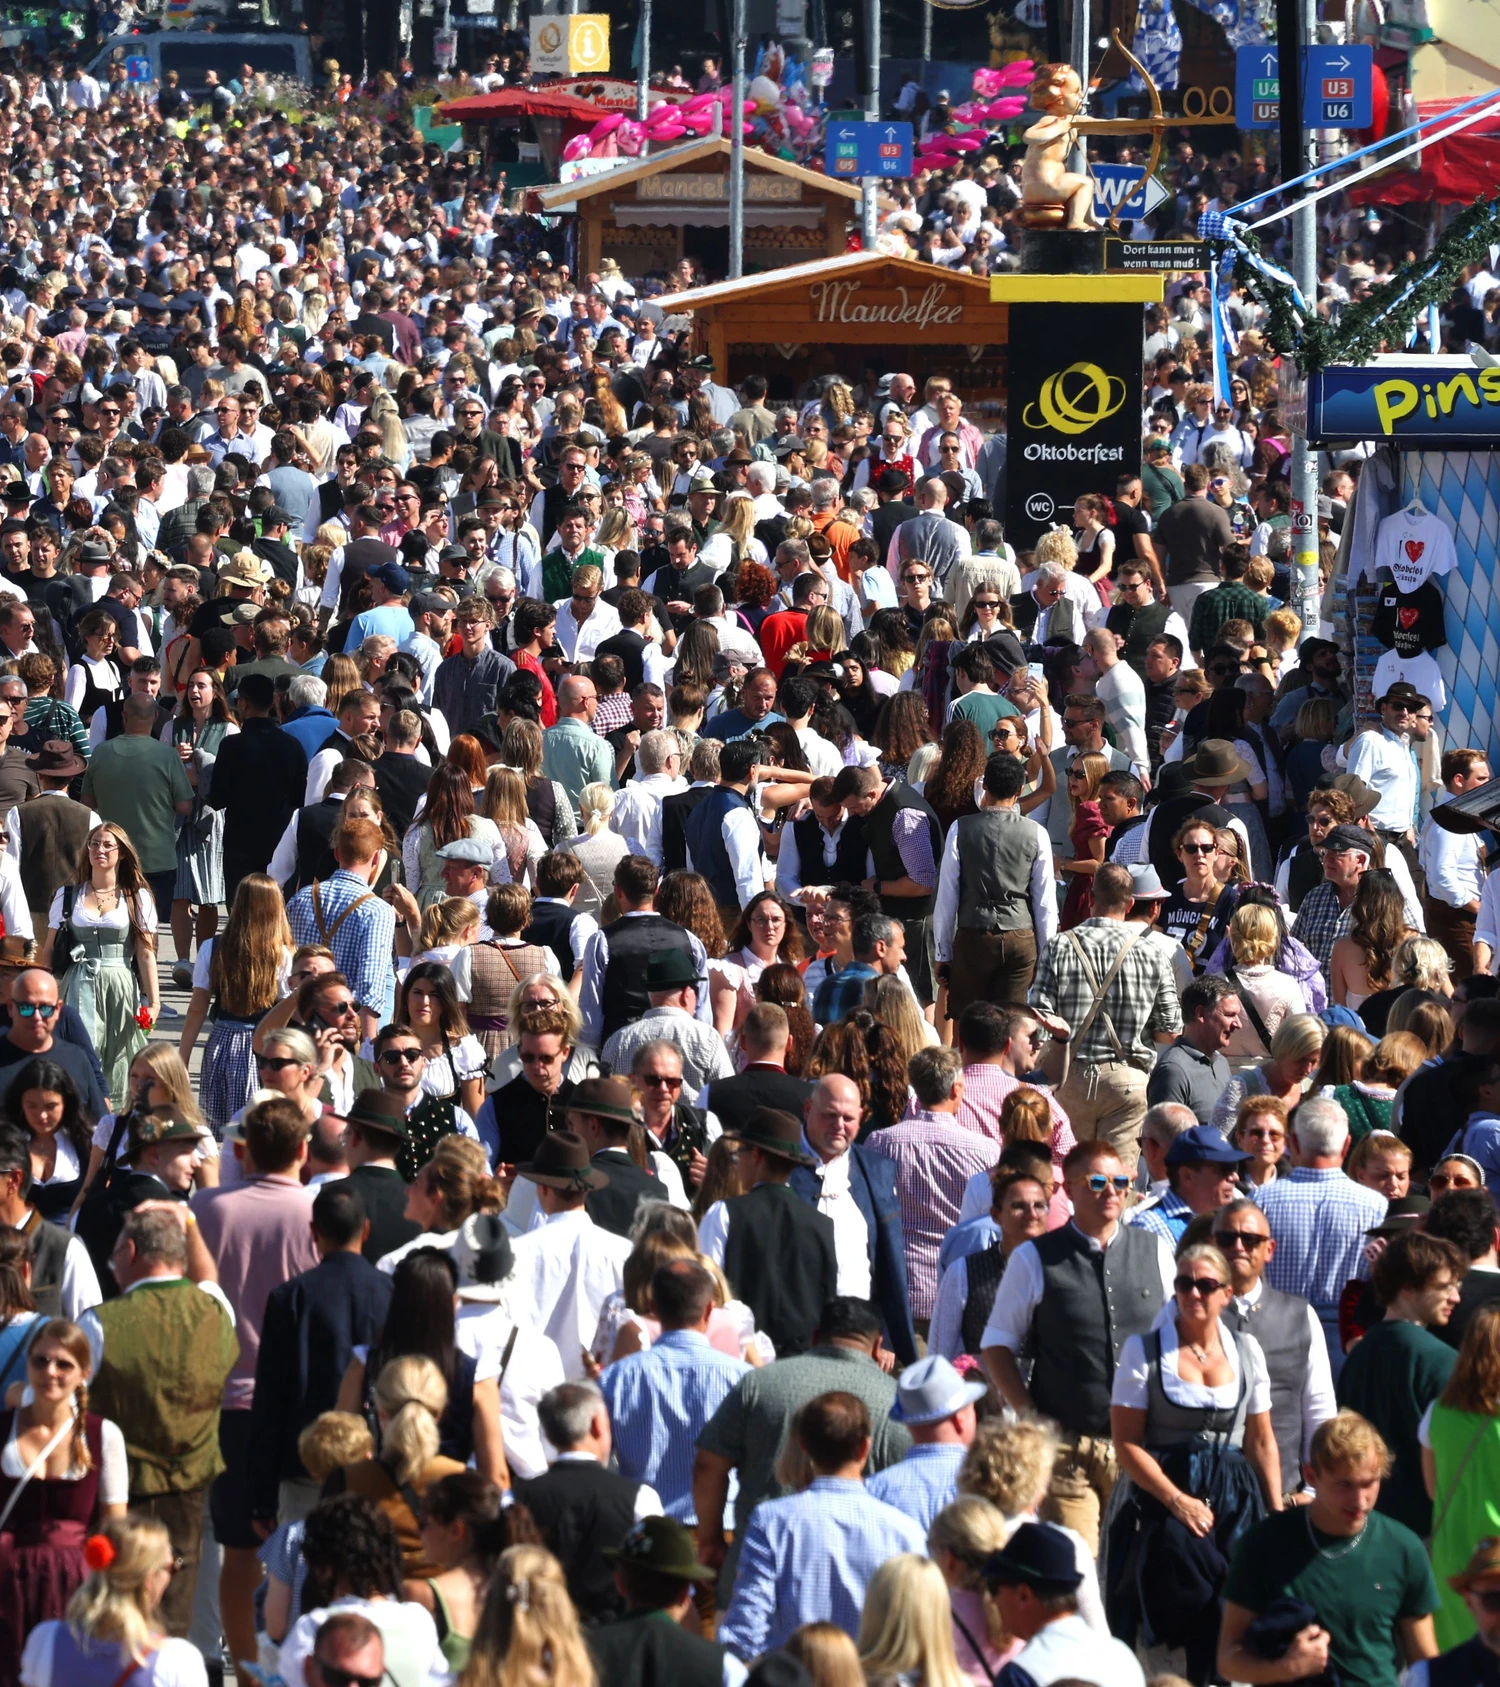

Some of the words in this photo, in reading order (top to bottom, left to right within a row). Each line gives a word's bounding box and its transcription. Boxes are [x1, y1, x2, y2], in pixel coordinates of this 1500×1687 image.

[1258, 82, 1280, 96] U4
[1328, 81, 1349, 95] U3
[1258, 104, 1280, 119] U5
[1327, 103, 1349, 118] U6
[839, 145, 854, 155] U4
[883, 146, 897, 155] U3
[839, 160, 854, 170] U5
[883, 160, 897, 170] U6
[640, 174, 724, 199] Mandel
[747, 177, 800, 199] Max
[1094, 177, 1144, 207] WC
[1123, 245, 1146, 255] Dort
[1147, 245, 1172, 255] kann
[1173, 246, 1195, 255] man
[1123, 260, 1148, 268] wenn
[1150, 260, 1172, 268] man
[1173, 259, 1194, 269] muß
[809, 280, 964, 331] Mandelfee
[1024, 443, 1124, 465] Oktoberfest
[1030, 502, 1050, 513] WC
